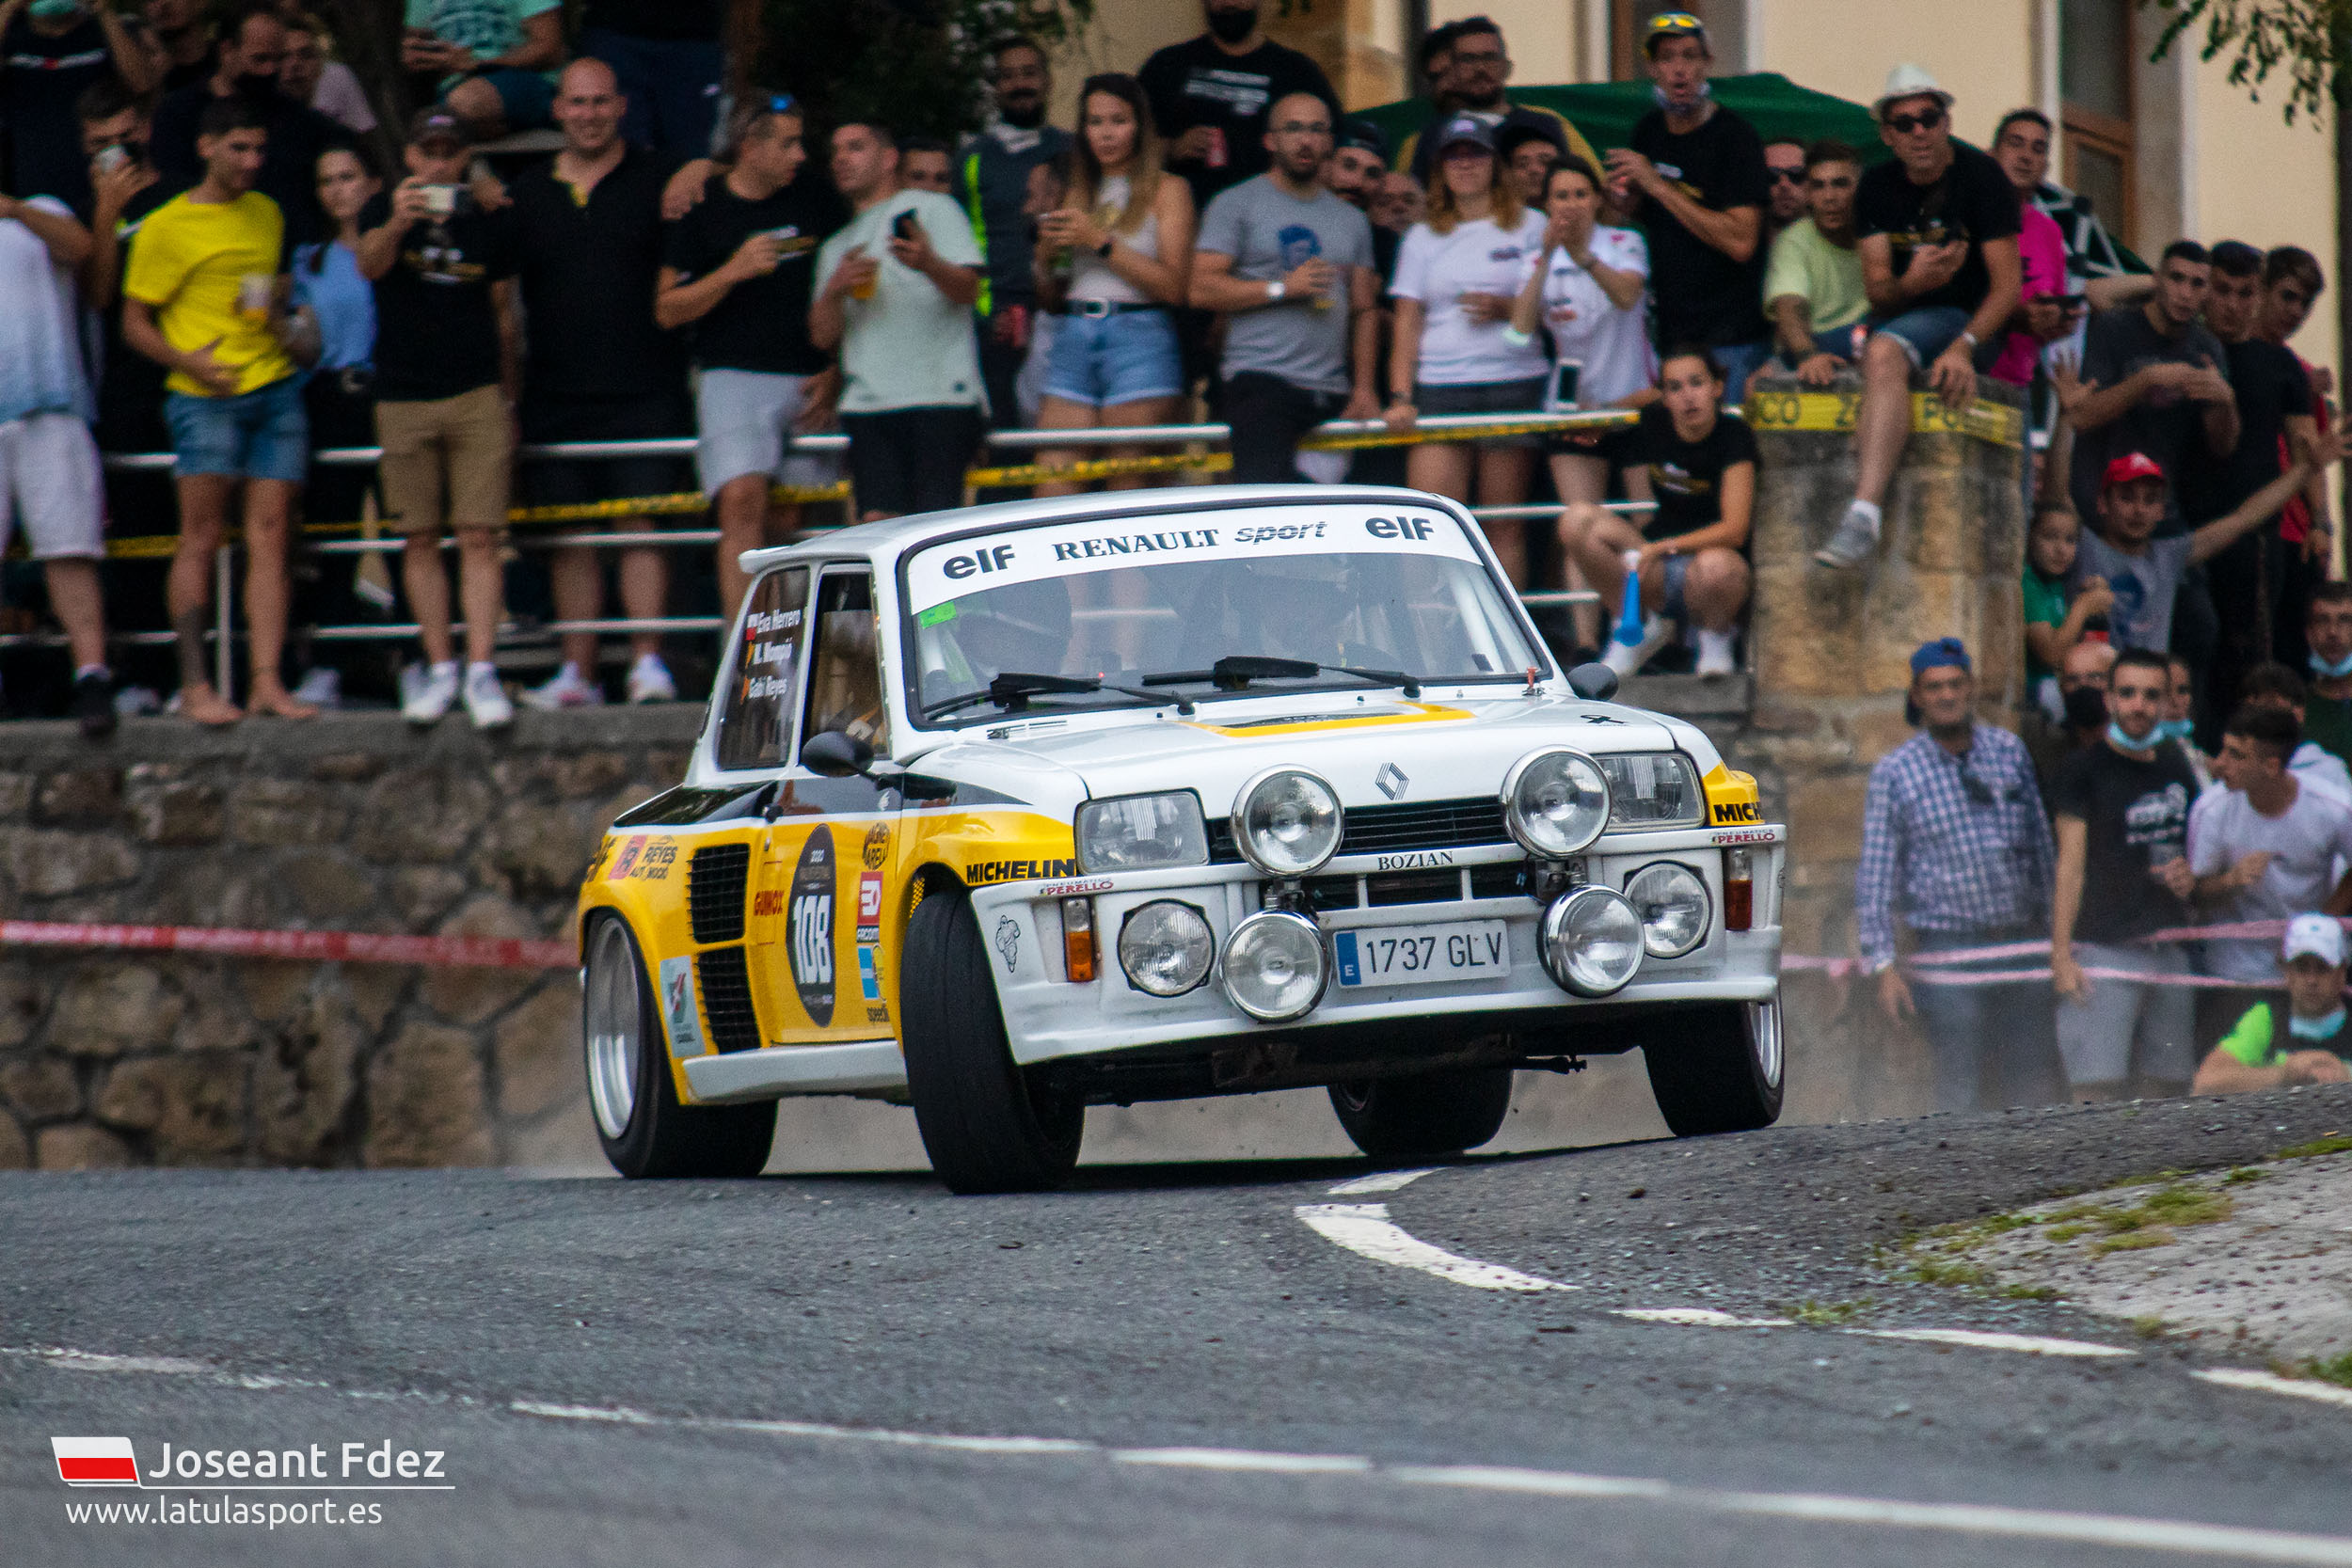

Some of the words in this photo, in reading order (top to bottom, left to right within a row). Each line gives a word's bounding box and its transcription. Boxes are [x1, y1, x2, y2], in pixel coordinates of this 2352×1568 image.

[1052, 529, 1220, 562] RENAULT
[1233, 520, 1328, 546] sport
[1365, 515, 1435, 541] elf
[943, 544, 1016, 579] elf
[1717, 832, 1776, 844] PERELLO
[642, 846, 678, 864] REYES
[1377, 850, 1454, 871] BOZIAN
[966, 858, 1075, 885] MICHELIN
[1047, 880, 1115, 895] PERELLO
[794, 895, 833, 985] 108
[1366, 936, 1437, 974] 1737
[1448, 931, 1502, 969] GLV
[1344, 964, 1355, 977] E
